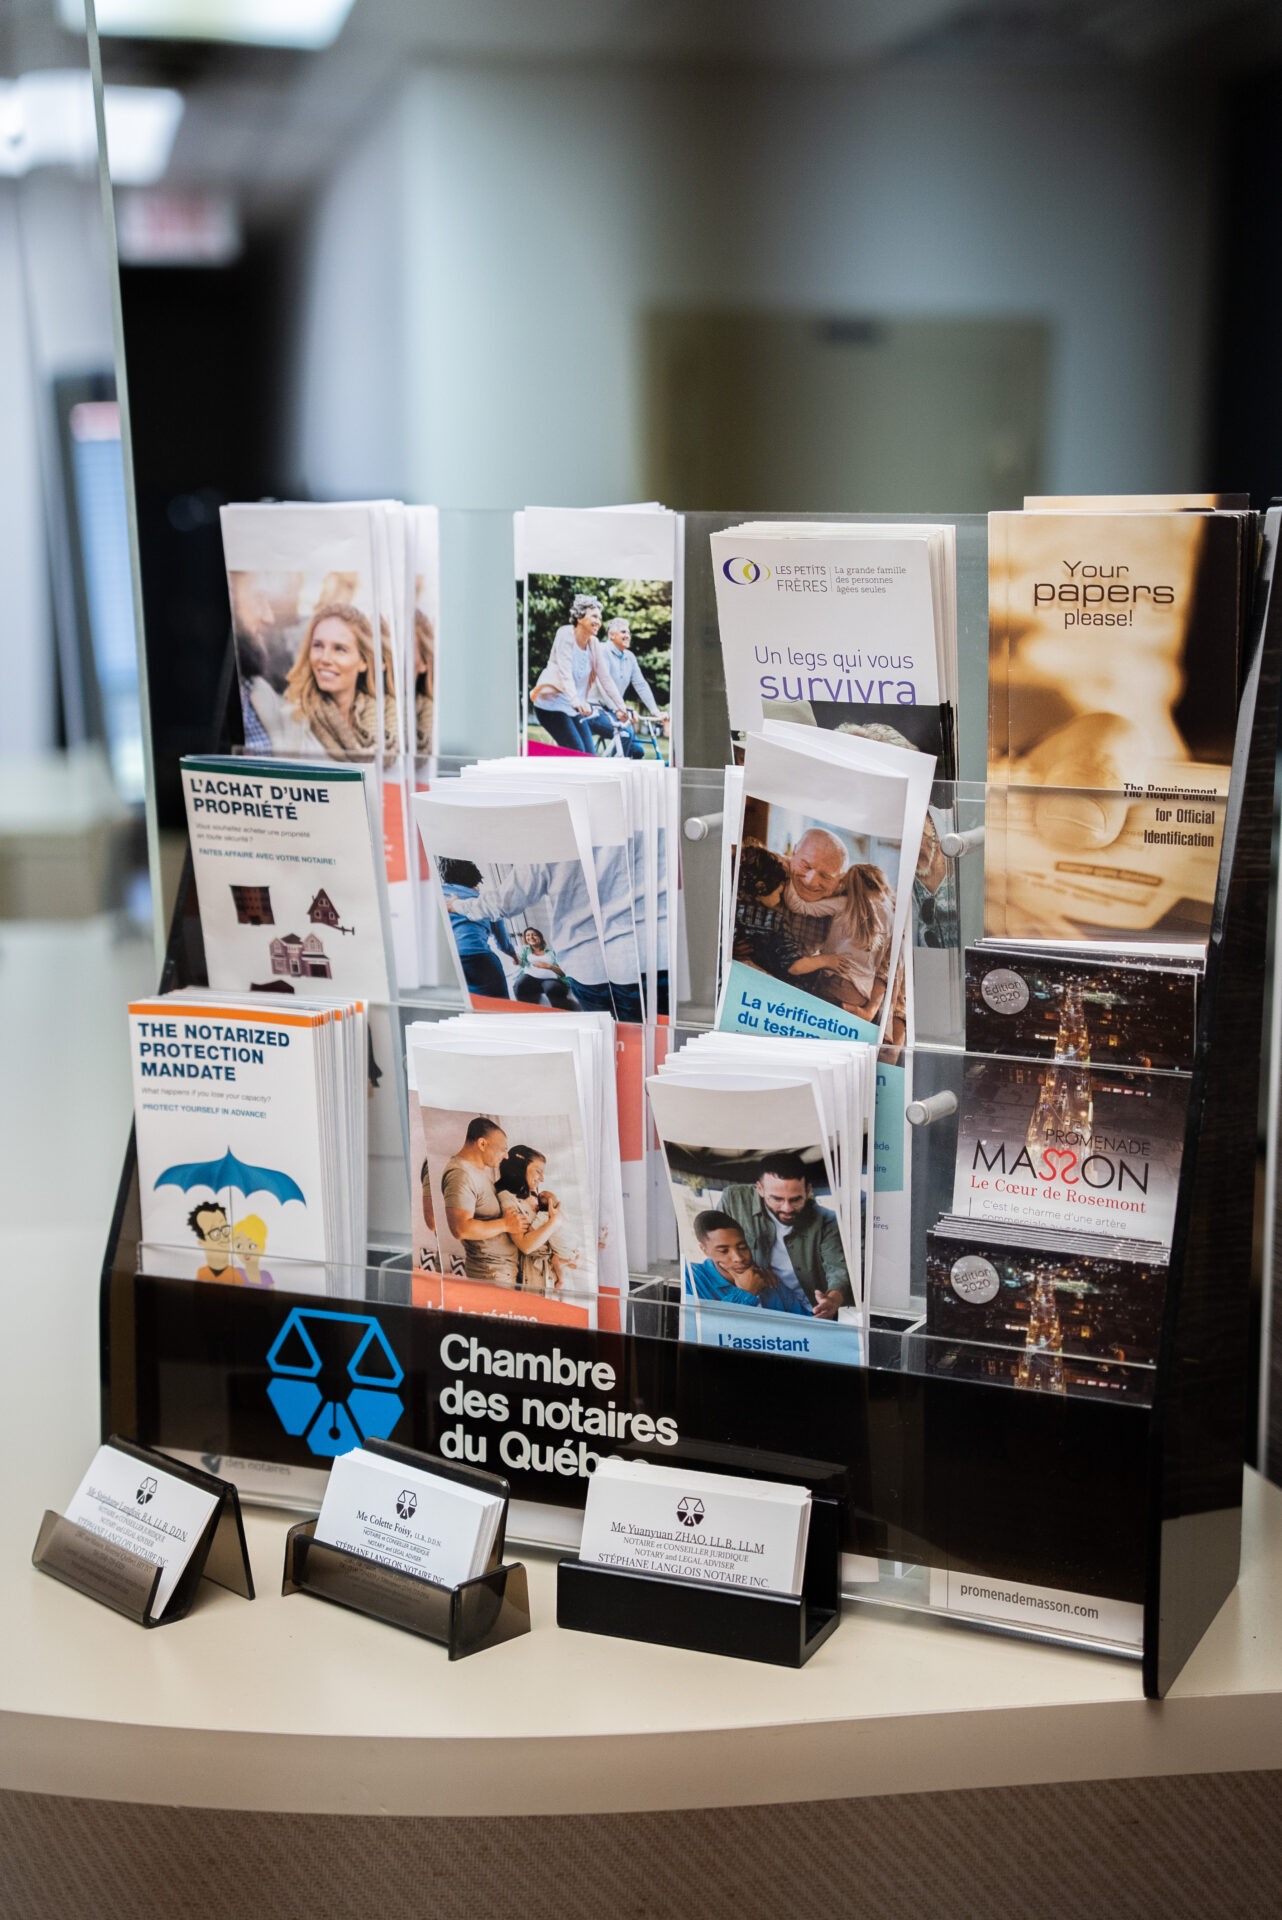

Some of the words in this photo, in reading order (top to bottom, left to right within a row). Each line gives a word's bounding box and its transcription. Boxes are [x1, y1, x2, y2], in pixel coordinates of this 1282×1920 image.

[775, 565, 792, 575] LES
[834, 566, 844, 574] La
[847, 566, 875, 576] grande
[877, 566, 907, 574] famille
[1063, 560, 1129, 578] Your
[776, 576, 828, 593] FRÈRES
[836, 576, 849, 584] des
[852, 577, 893, 586] personnes
[860, 585, 886, 593] seules
[1034, 583, 1175, 608] papers
[1064, 609, 1133, 630] please!
[755, 645, 782, 665] Un
[787, 646, 828, 671] legs
[833, 649, 862, 673] qui
[867, 654, 914, 669] vous
[760, 669, 917, 706] survivra
[190, 778, 264, 798] L'ACHAT
[270, 785, 330, 803] D'UNE
[193, 797, 298, 820] PROPRIÉTÉ
[1155, 808, 1172, 822] for
[1176, 809, 1215, 824] Official
[1143, 829, 1214, 847] Identification
[199, 848, 223, 856] FAITES
[224, 850, 253, 859] AFFAIRE
[256, 852, 274, 860] AVEC
[276, 854, 300, 863] VOTRE
[993, 991, 1021, 1005] 2020
[737, 1011, 759, 1028] du
[741, 991, 762, 1010] La
[767, 1002, 859, 1040] vérification
[137, 1022, 177, 1038] THE
[184, 1024, 290, 1048] NOTARIZED
[139, 1042, 264, 1065] PROTECTION
[141, 1062, 237, 1081] MANDATE
[141, 1087, 159, 1095] What
[160, 1088, 190, 1098] happens
[197, 1091, 210, 1099] you
[210, 1090, 224, 1098] lose
[225, 1093, 241, 1101] your
[241, 1094, 271, 1103] capacity?
[142, 1103, 179, 1112] PROTECT
[181, 1105, 220, 1115] YOURSELF
[231, 1109, 267, 1119] ADVANCE!
[1045, 1128, 1150, 1157] PROMENADE
[972, 1139, 1149, 1195] MASSON
[970, 1175, 989, 1190] Le
[1043, 1186, 1061, 1201] de
[1066, 1189, 1147, 1214] Rosemont
[1011, 1203, 1020, 1214] le
[1022, 1206, 1061, 1220] charme
[1095, 1217, 1127, 1230] artère
[962, 1278, 991, 1293] 2020
[439, 1333, 616, 1391] Chambre
[439, 1379, 510, 1422] des
[522, 1397, 679, 1446] notaires
[439, 1424, 487, 1463] du
[499, 1430, 650, 1478] Québ
[225, 1456, 245, 1469] des
[248, 1459, 291, 1475] notaires
[356, 1510, 369, 1521] Me
[368, 1514, 393, 1529] Colette
[393, 1522, 414, 1538] Foisy,
[362, 1529, 381, 1539] NOTAIRE
[611, 1521, 626, 1533] Me
[628, 1524, 673, 1540] Yuanyuan
[624, 1537, 655, 1548] NOTAIRE
[663, 1544, 709, 1556] CONSEILLER
[709, 1550, 749, 1562] JURIDIQUE
[635, 1548, 664, 1559] NOTARY
[678, 1555, 702, 1565] LEGAL
[704, 1559, 735, 1570] ADVISER
[598, 1552, 649, 1569] STÉPHANE
[651, 1561, 701, 1577] LANGLOIS
[703, 1569, 748, 1584] NOTAIRE
[960, 1583, 1099, 1619] promenademasson.com
